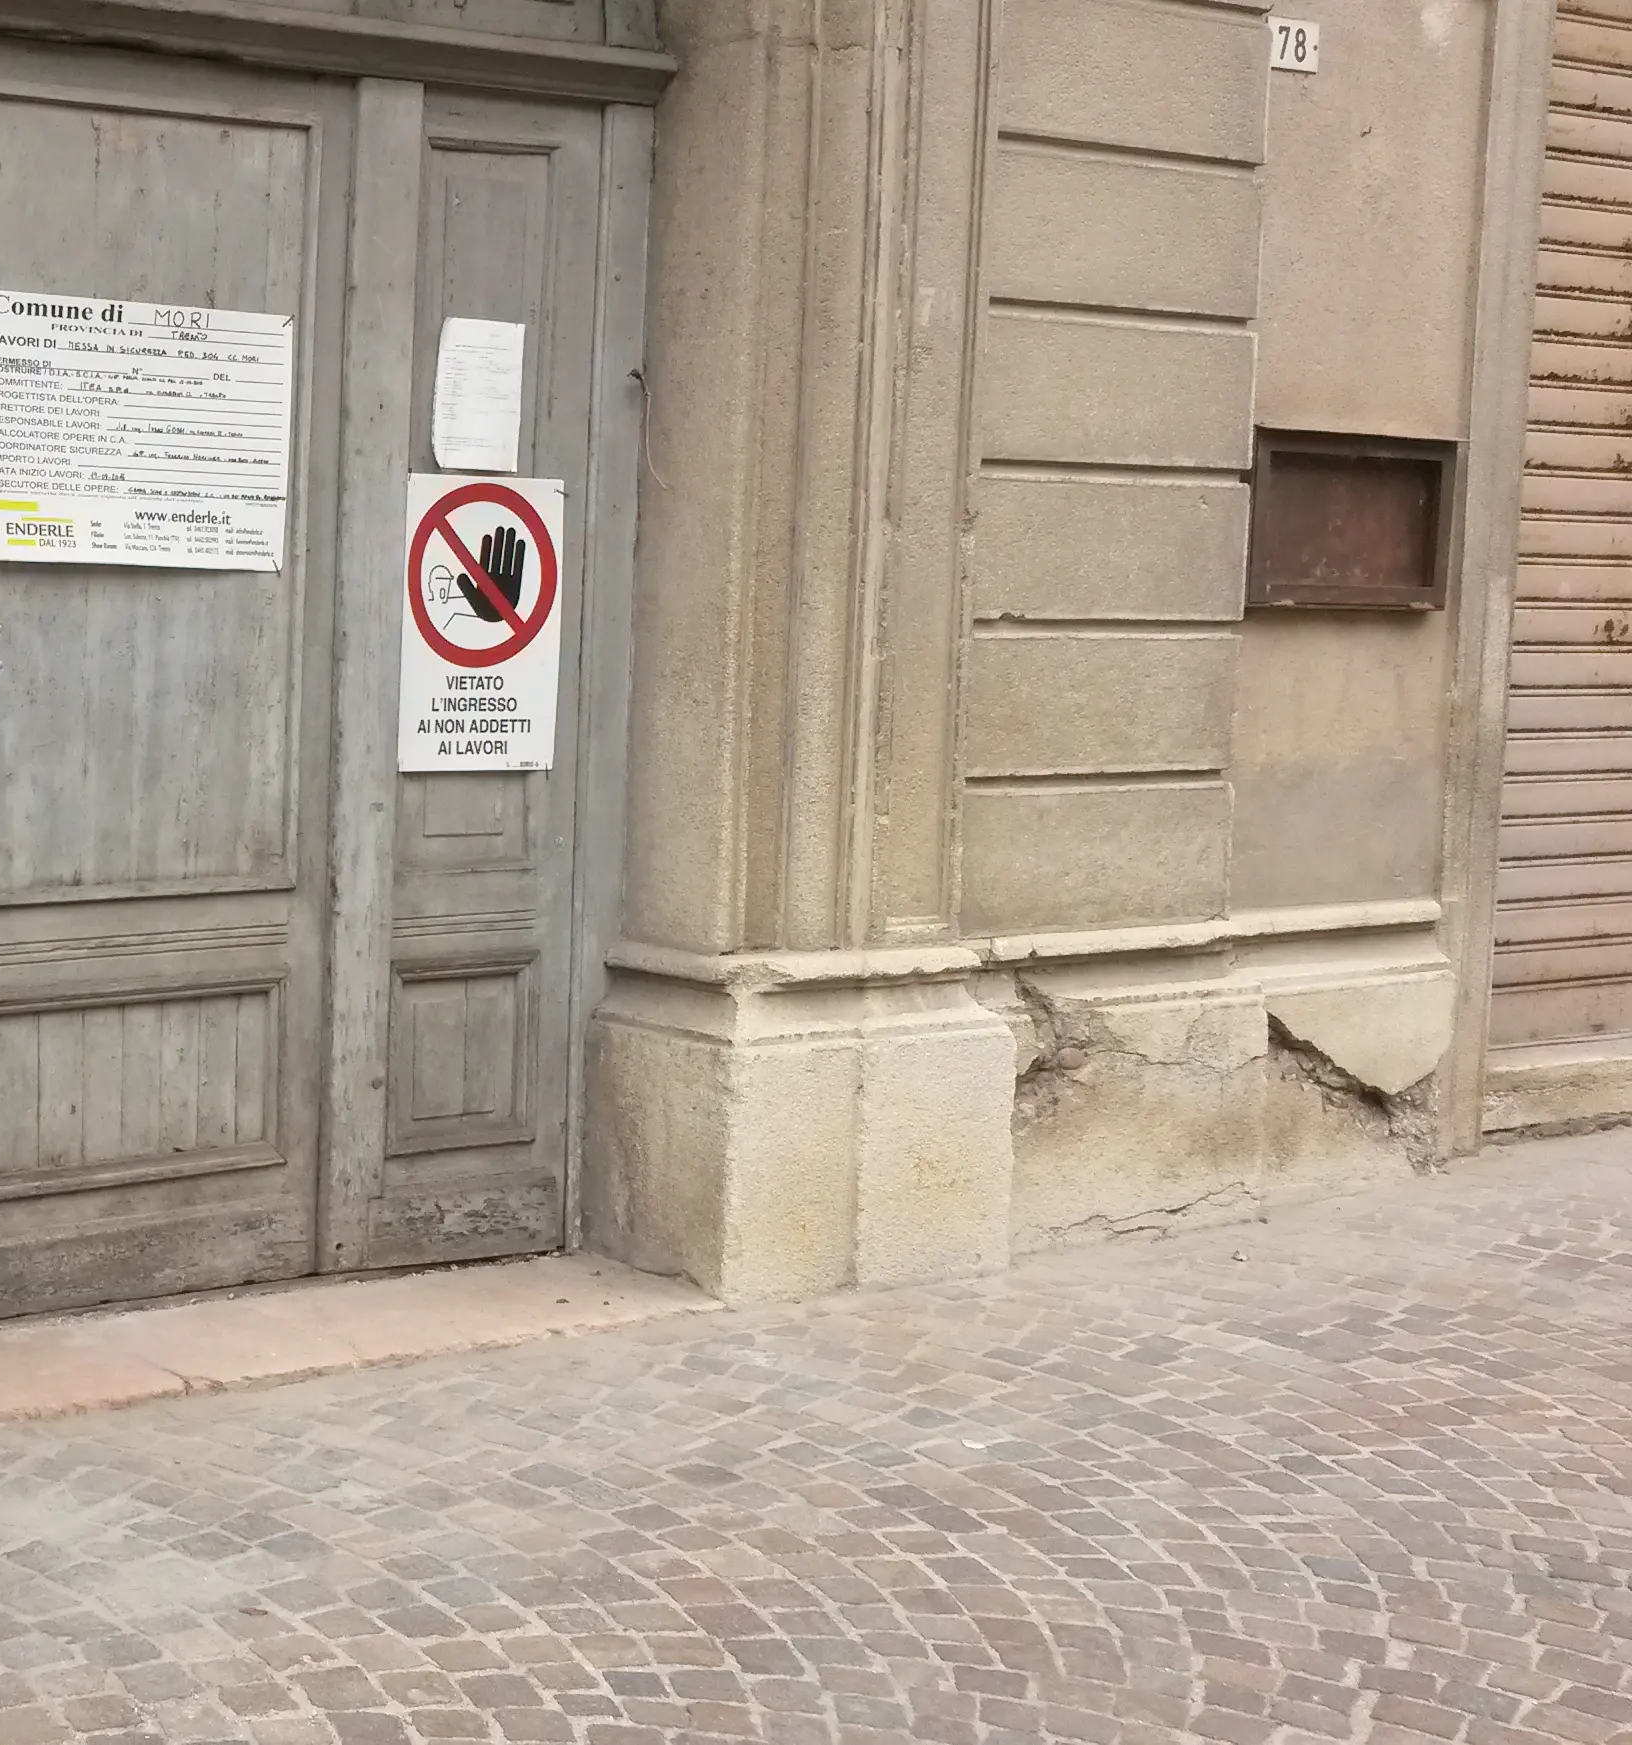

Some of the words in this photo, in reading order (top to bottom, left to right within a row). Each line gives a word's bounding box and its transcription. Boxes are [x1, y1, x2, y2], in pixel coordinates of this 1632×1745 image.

[1278, 25, 1307, 63] 78
[101, 304, 123, 323] di
[154, 309, 210, 329] MORI
[51, 323, 126, 336] PROVINCIA
[129, 328, 143, 337] DI
[43, 338, 57, 349] DI
[120, 344, 168, 356] SICUREZZA
[42, 360, 52, 368] DI
[213, 372, 231, 382] DEL
[47, 406, 64, 415] DEI
[62, 432, 95, 443] OPERE
[97, 435, 108, 443] IN
[19, 468, 47, 477] INIZIO
[48, 469, 85, 479] LAVORI:
[51, 482, 82, 492] DELLE
[83, 484, 119, 494] OPERE:
[134, 509, 232, 526] www.enderle.it
[6, 522, 75, 538] ENDERLE
[39, 538, 56, 548] DAL
[58, 539, 77, 549] 1923
[446, 675, 504, 691] VIETATO
[431, 697, 518, 712] L'INGRESSO
[417, 719, 431, 734] AI
[434, 719, 465, 734] NON
[469, 719, 531, 734] ADDETTI
[437, 740, 452, 755] AI
[456, 740, 508, 755] LAVORI
